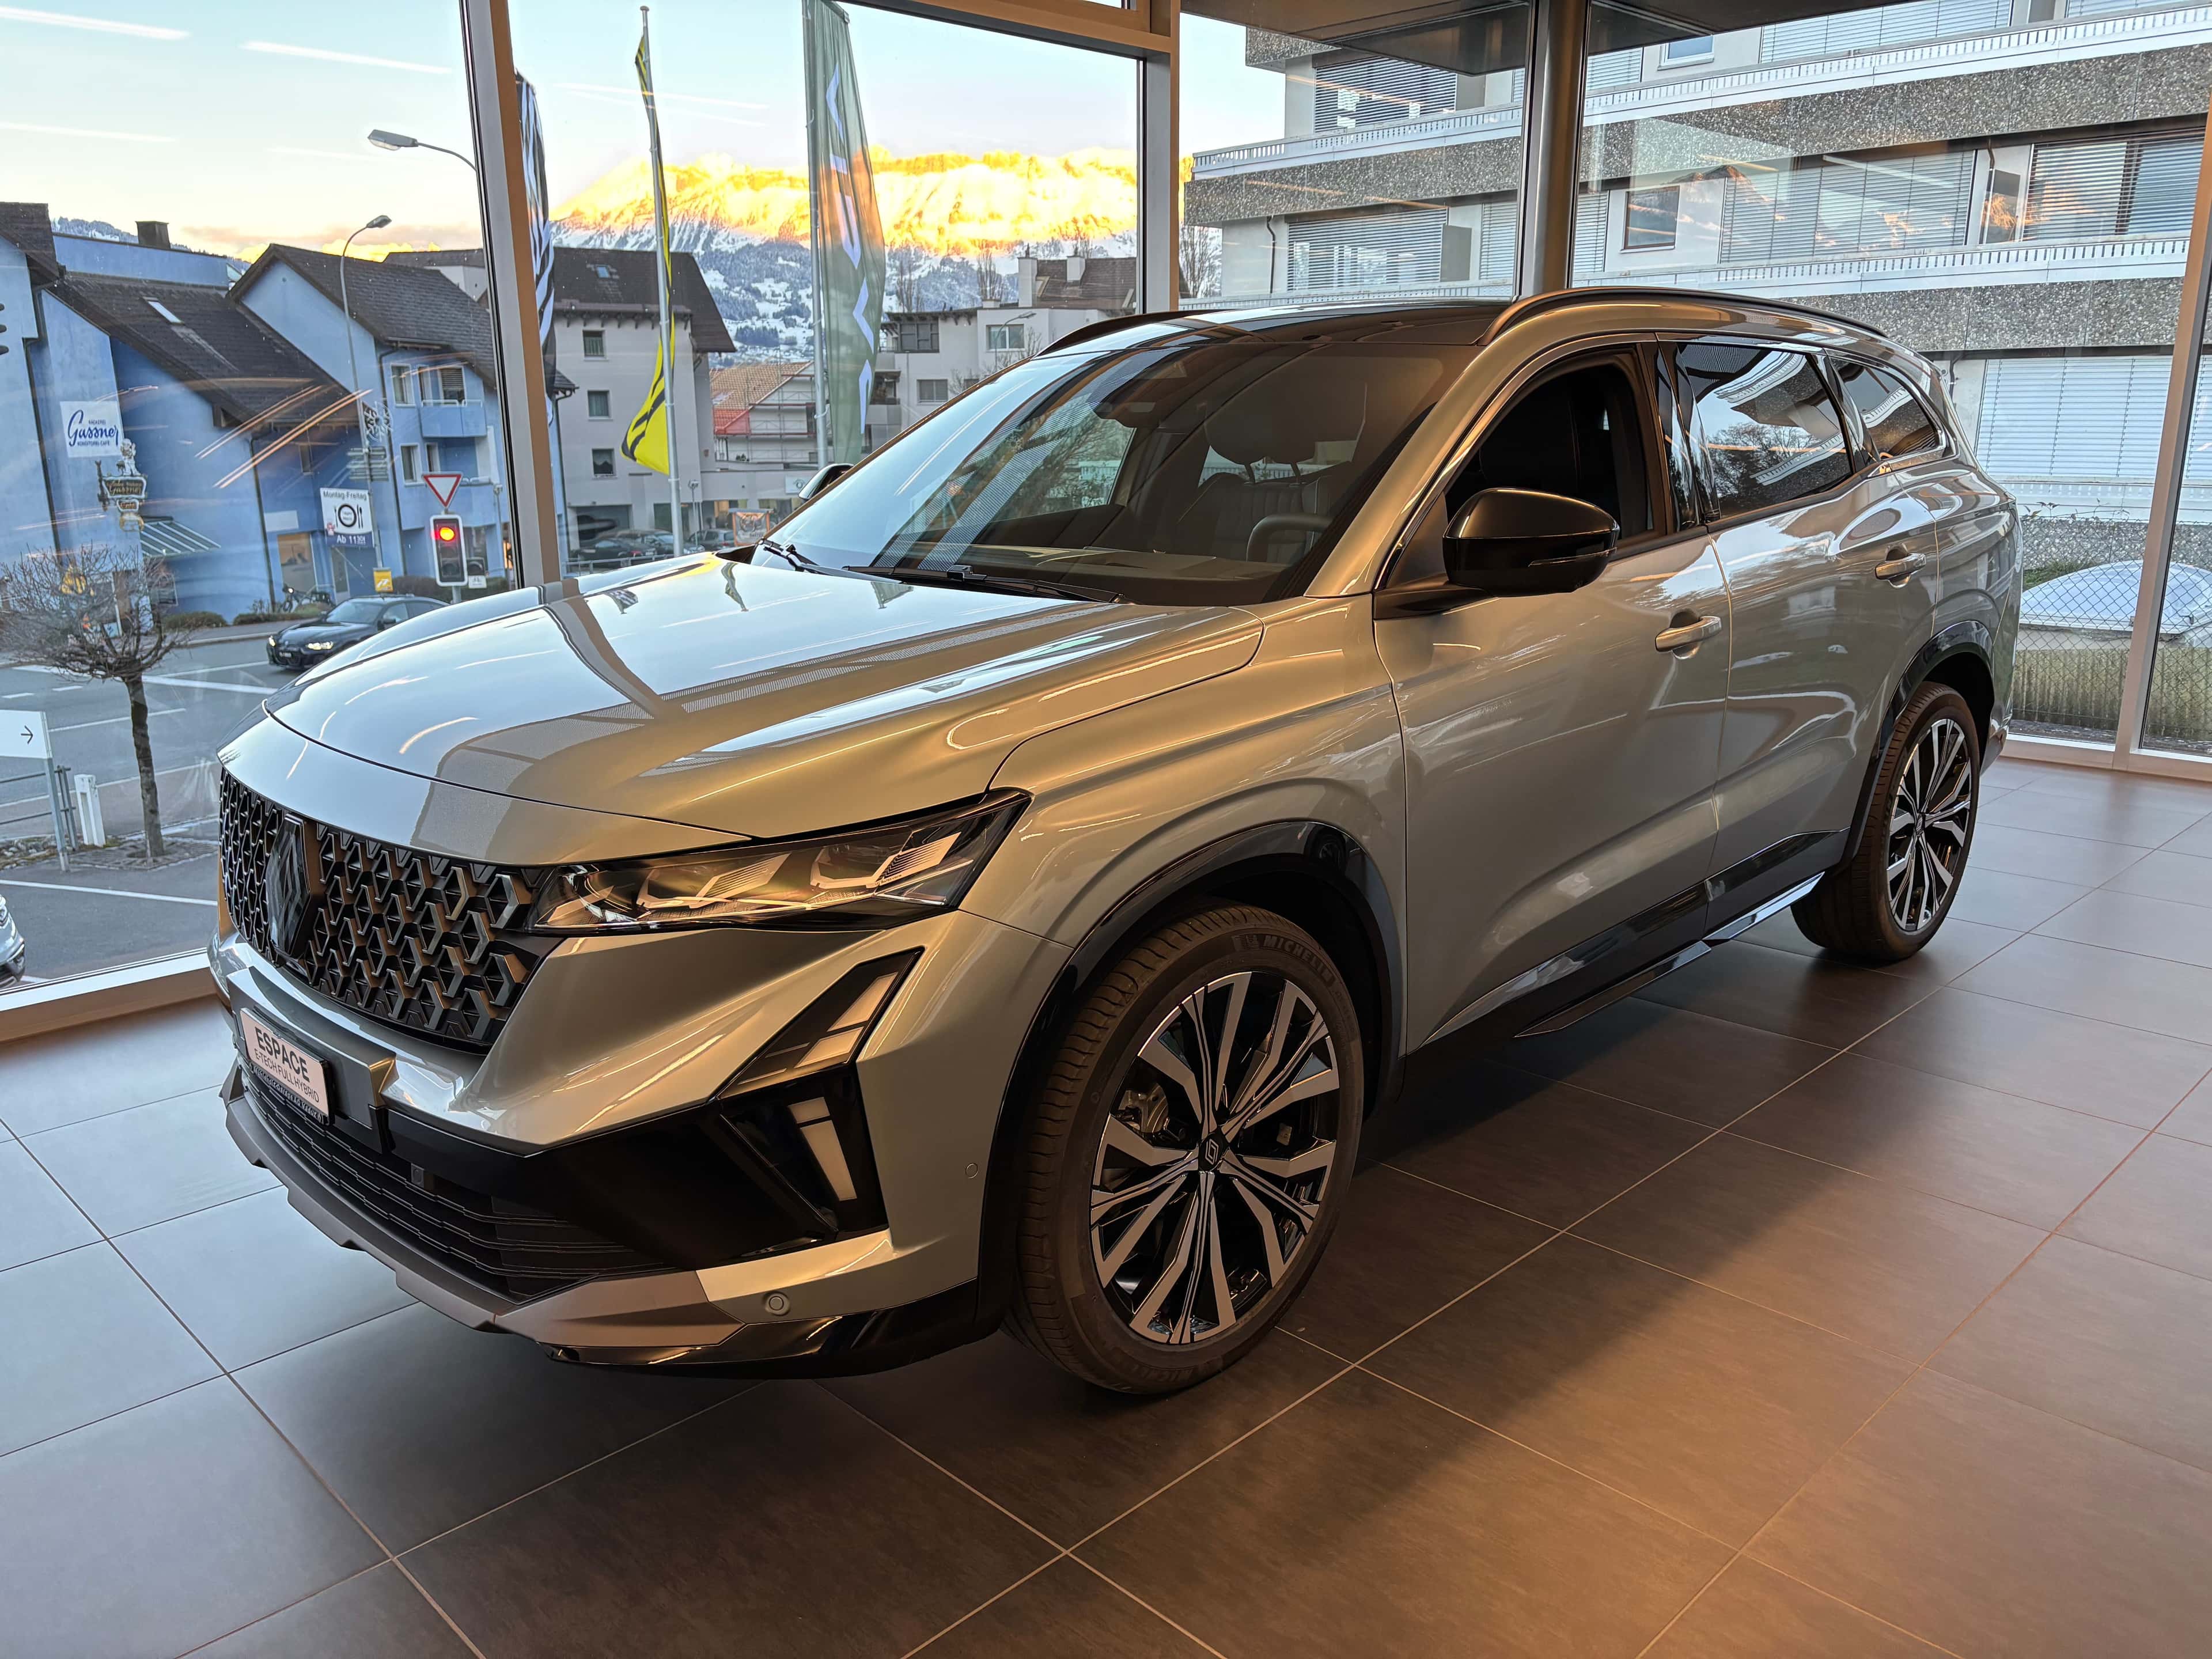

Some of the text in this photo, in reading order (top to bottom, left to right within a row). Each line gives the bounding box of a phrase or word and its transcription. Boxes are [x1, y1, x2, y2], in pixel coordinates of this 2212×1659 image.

[68, 410, 119, 447] Gassner
[336, 535, 347, 544] Ab
[1263, 934, 1334, 982] MICHELIN
[254, 1048, 278, 1073] E-TECH
[278, 1066, 294, 1085] FULL
[294, 1076, 319, 1103] HYBRID
[255, 1027, 310, 1083] ESPACE
